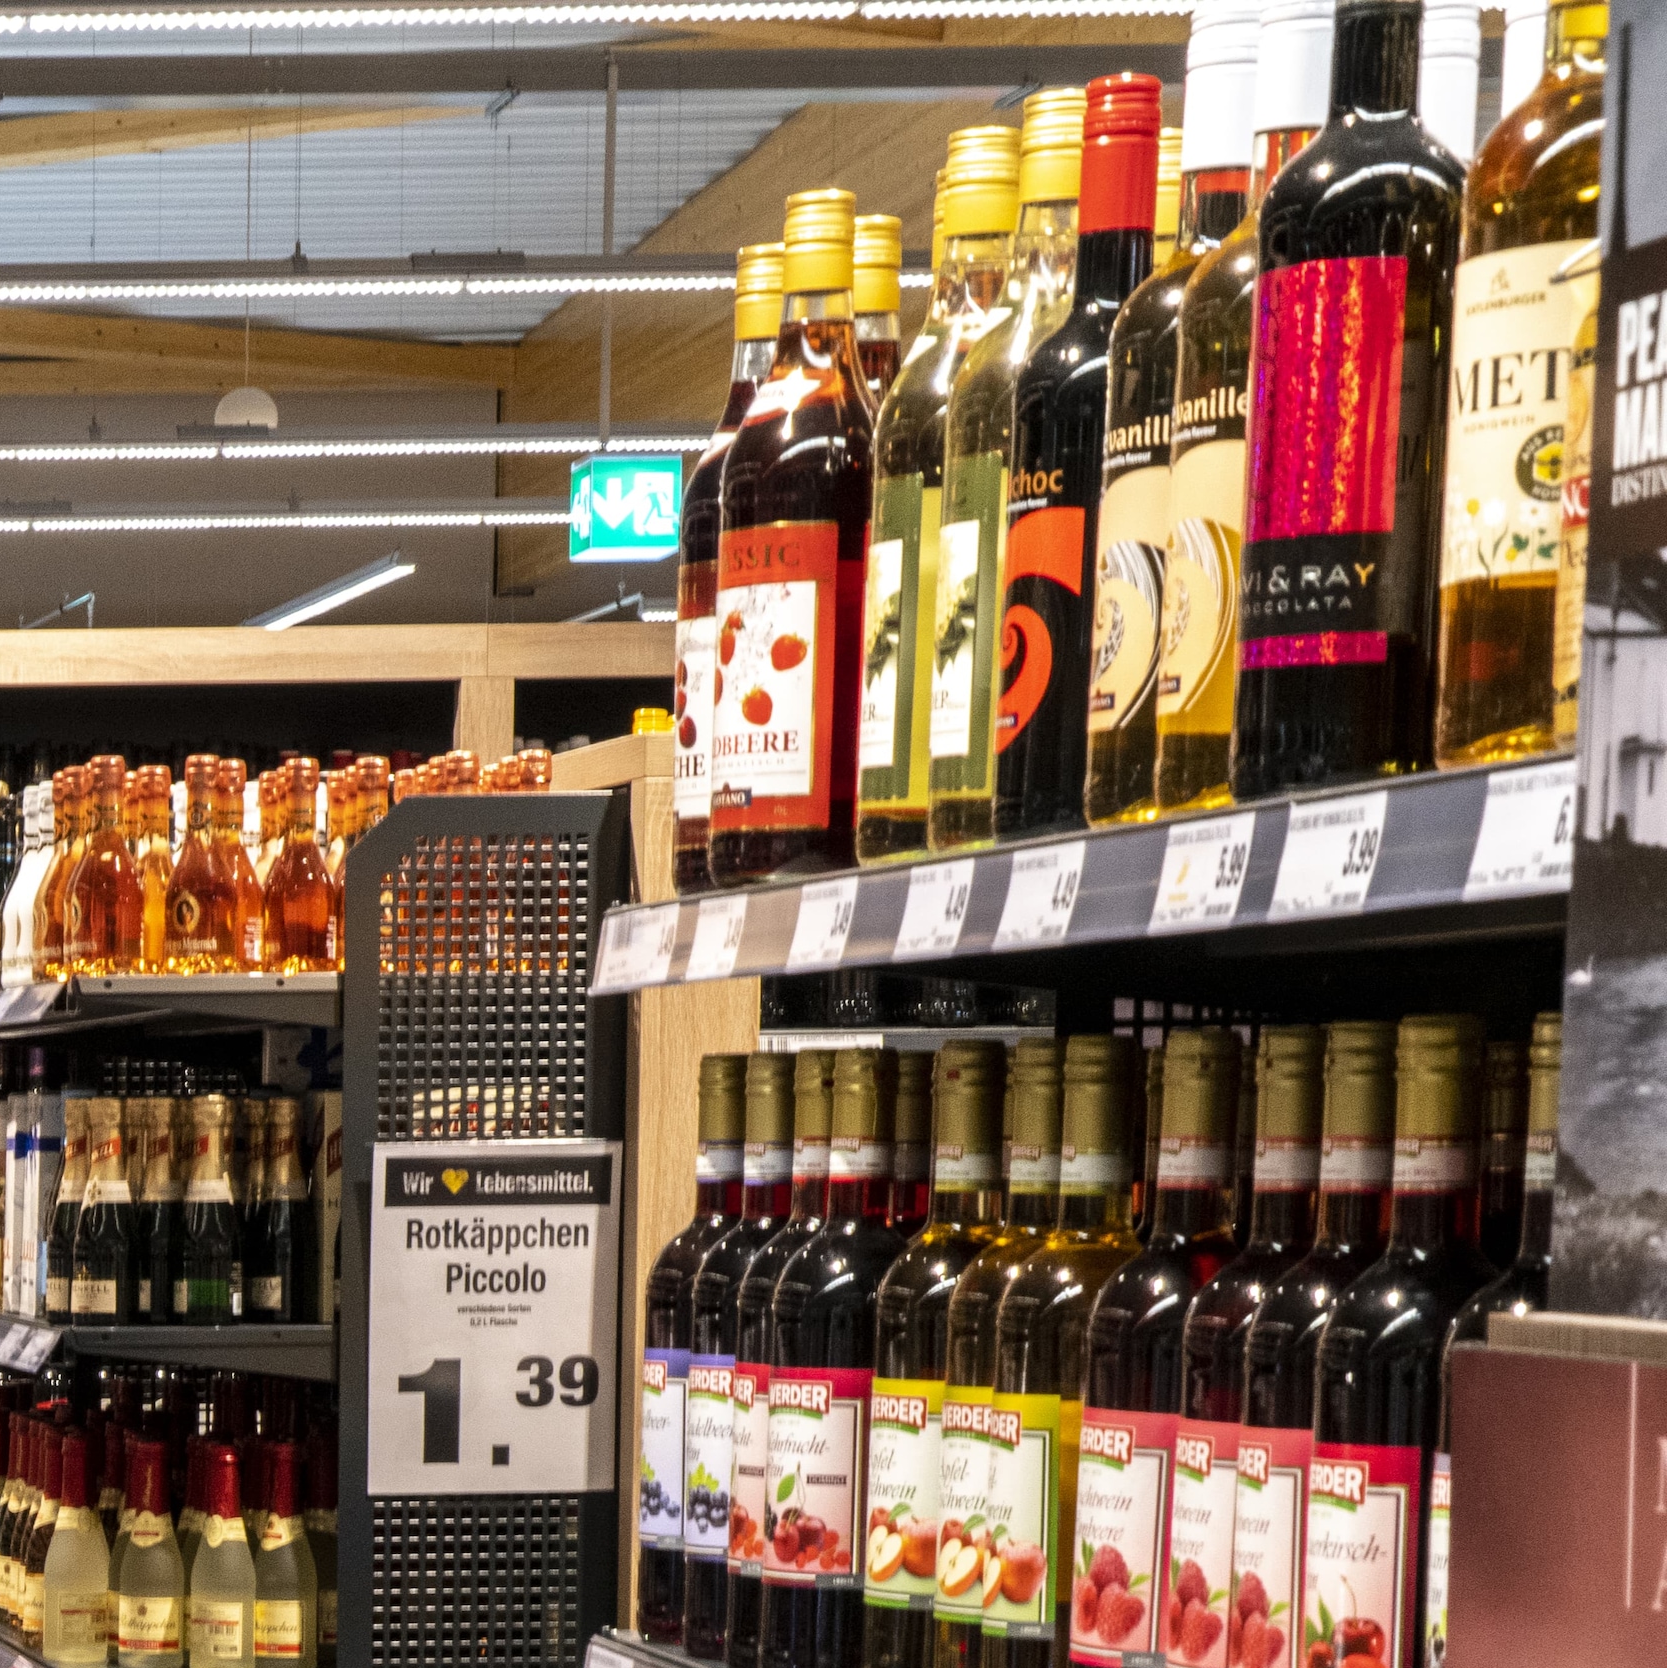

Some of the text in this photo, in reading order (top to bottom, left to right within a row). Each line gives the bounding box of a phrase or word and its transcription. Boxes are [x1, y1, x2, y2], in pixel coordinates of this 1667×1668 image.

[1299, 562, 1375, 588] RAY
[1215, 843, 1247, 890] 5.99
[1342, 829, 1379, 878] 3.99
[402, 1170, 594, 1195] Wir Lebensmittel.
[405, 1217, 590, 1256] Rotkäppchen
[446, 1262, 546, 1293] Piccolo
